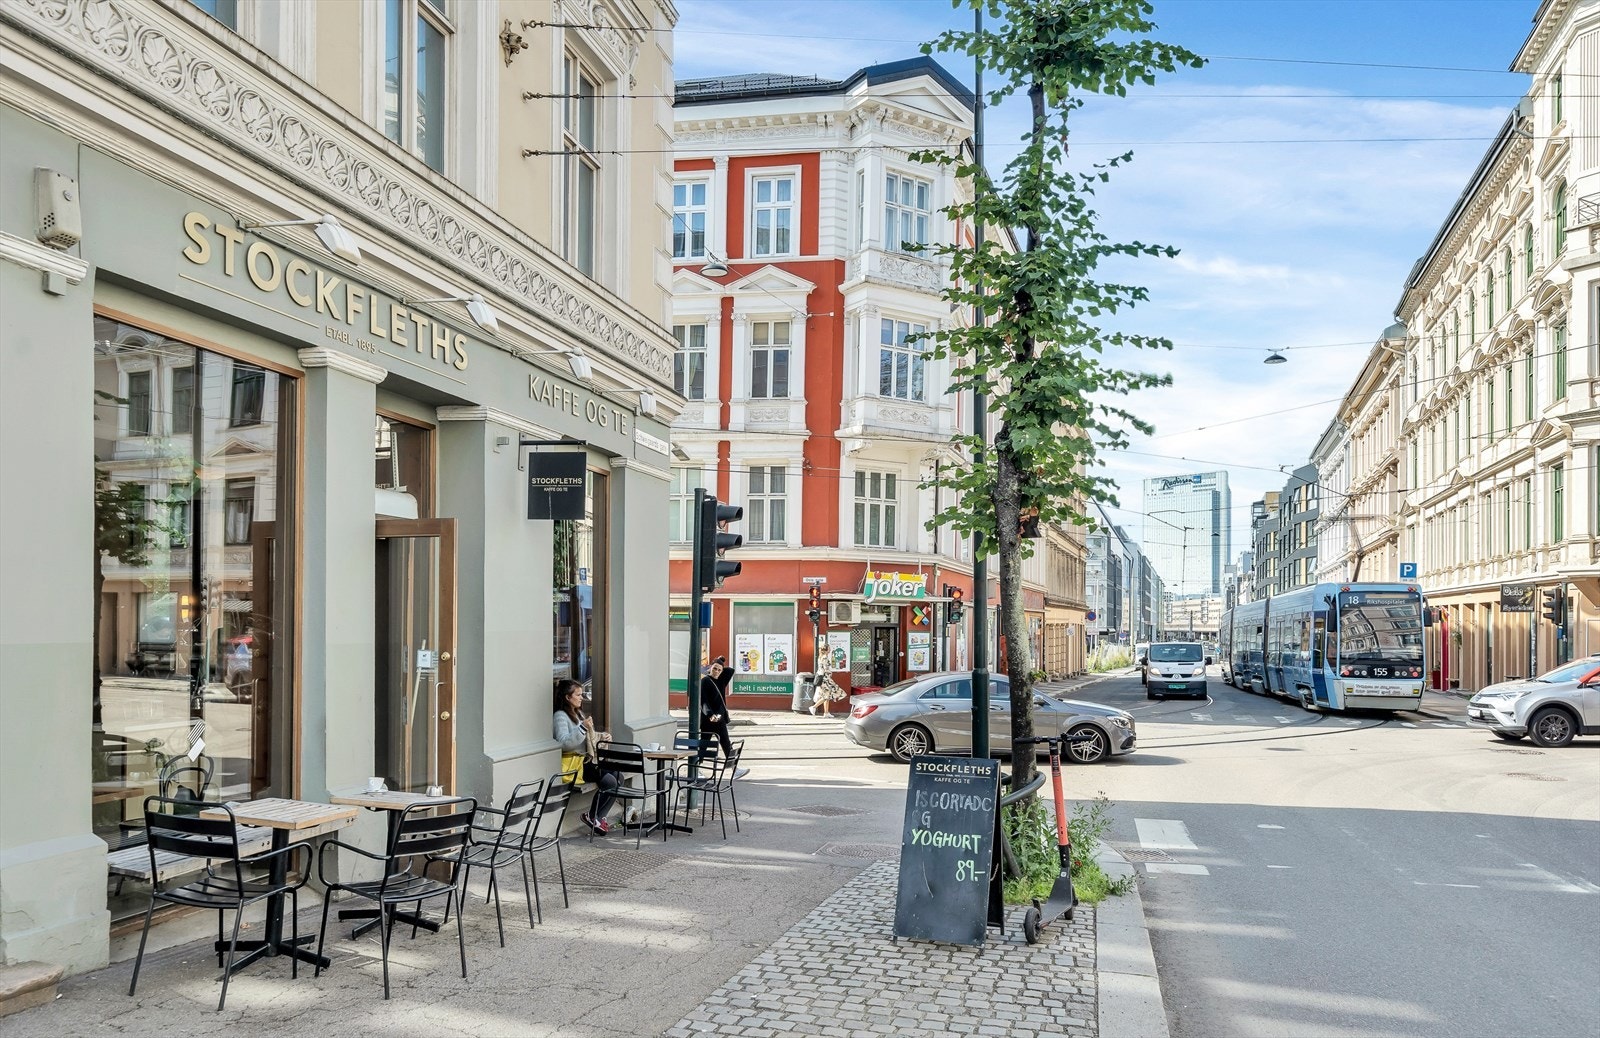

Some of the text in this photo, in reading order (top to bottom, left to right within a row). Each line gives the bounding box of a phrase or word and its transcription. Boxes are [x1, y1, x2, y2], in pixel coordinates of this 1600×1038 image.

[182, 211, 468, 371] STOCKFLETHS
[325, 325, 376, 354] ETABL. 1895
[528, 374, 628, 436] KAFFE OG TE
[531, 477, 583, 485] STOCKFLETHS
[1403, 565, 1413, 576] P
[865, 571, 926, 604] joker
[1348, 596, 1359, 604] 18
[1373, 667, 1388, 676] 155
[916, 762, 991, 775] STOCKFLETHS
[911, 828, 982, 854] YOGHURT
